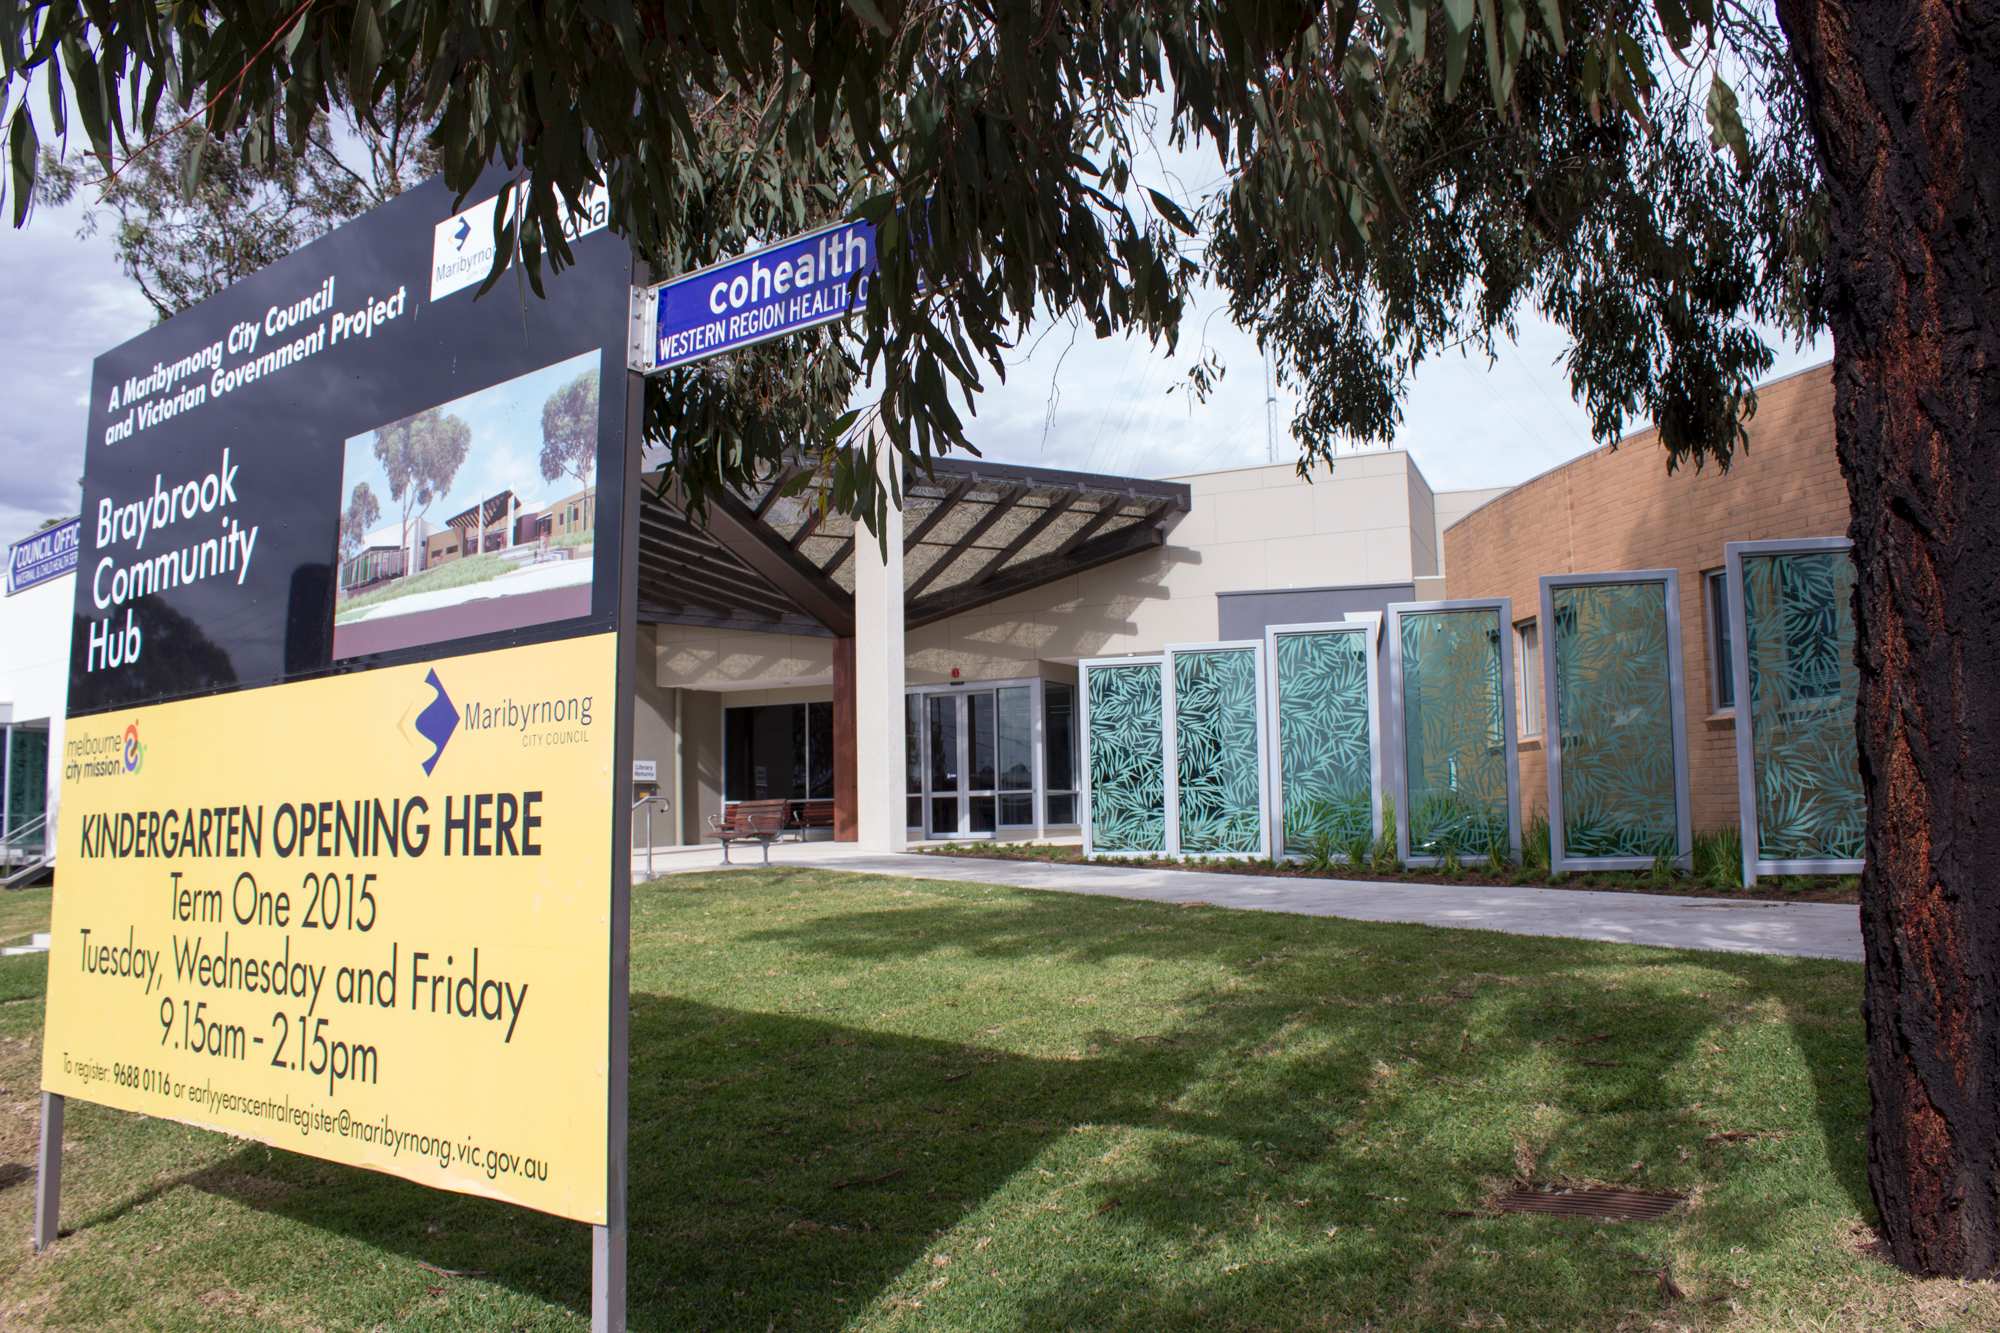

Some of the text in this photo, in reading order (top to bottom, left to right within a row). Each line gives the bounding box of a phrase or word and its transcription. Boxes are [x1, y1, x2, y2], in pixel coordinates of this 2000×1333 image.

[436, 247, 493, 282] Maribyrno
[709, 228, 867, 315] cohealth
[108, 276, 335, 413] A Maribyrnong City Council
[659, 319, 726, 361] WESTERN
[729, 301, 785, 340] REGION
[105, 285, 406, 446] and Victorian Government Project
[96, 447, 239, 550] Braybrook
[16, 536, 53, 568] COUNCIL
[54, 522, 80, 553] OFFIC
[93, 517, 259, 609] Community
[87, 608, 141, 673] Hub
[67, 732, 122, 757] melbourne
[465, 696, 593, 732] Maribyrnong
[522, 730, 589, 748] CITY COUNCIL
[65, 759, 82, 784] city
[80, 791, 543, 859] KINDERGARTEN OPENING HERE
[170, 871, 377, 932] Term One 2015
[80, 925, 528, 1043] Tuesday, Wednesday and Friday
[160, 996, 378, 1097] 9.15am - 2.15pm
[63, 1052, 548, 1181] To register: 9688 0116 or earlyyearscentralregister@maribyrnong.vic.gov.au
